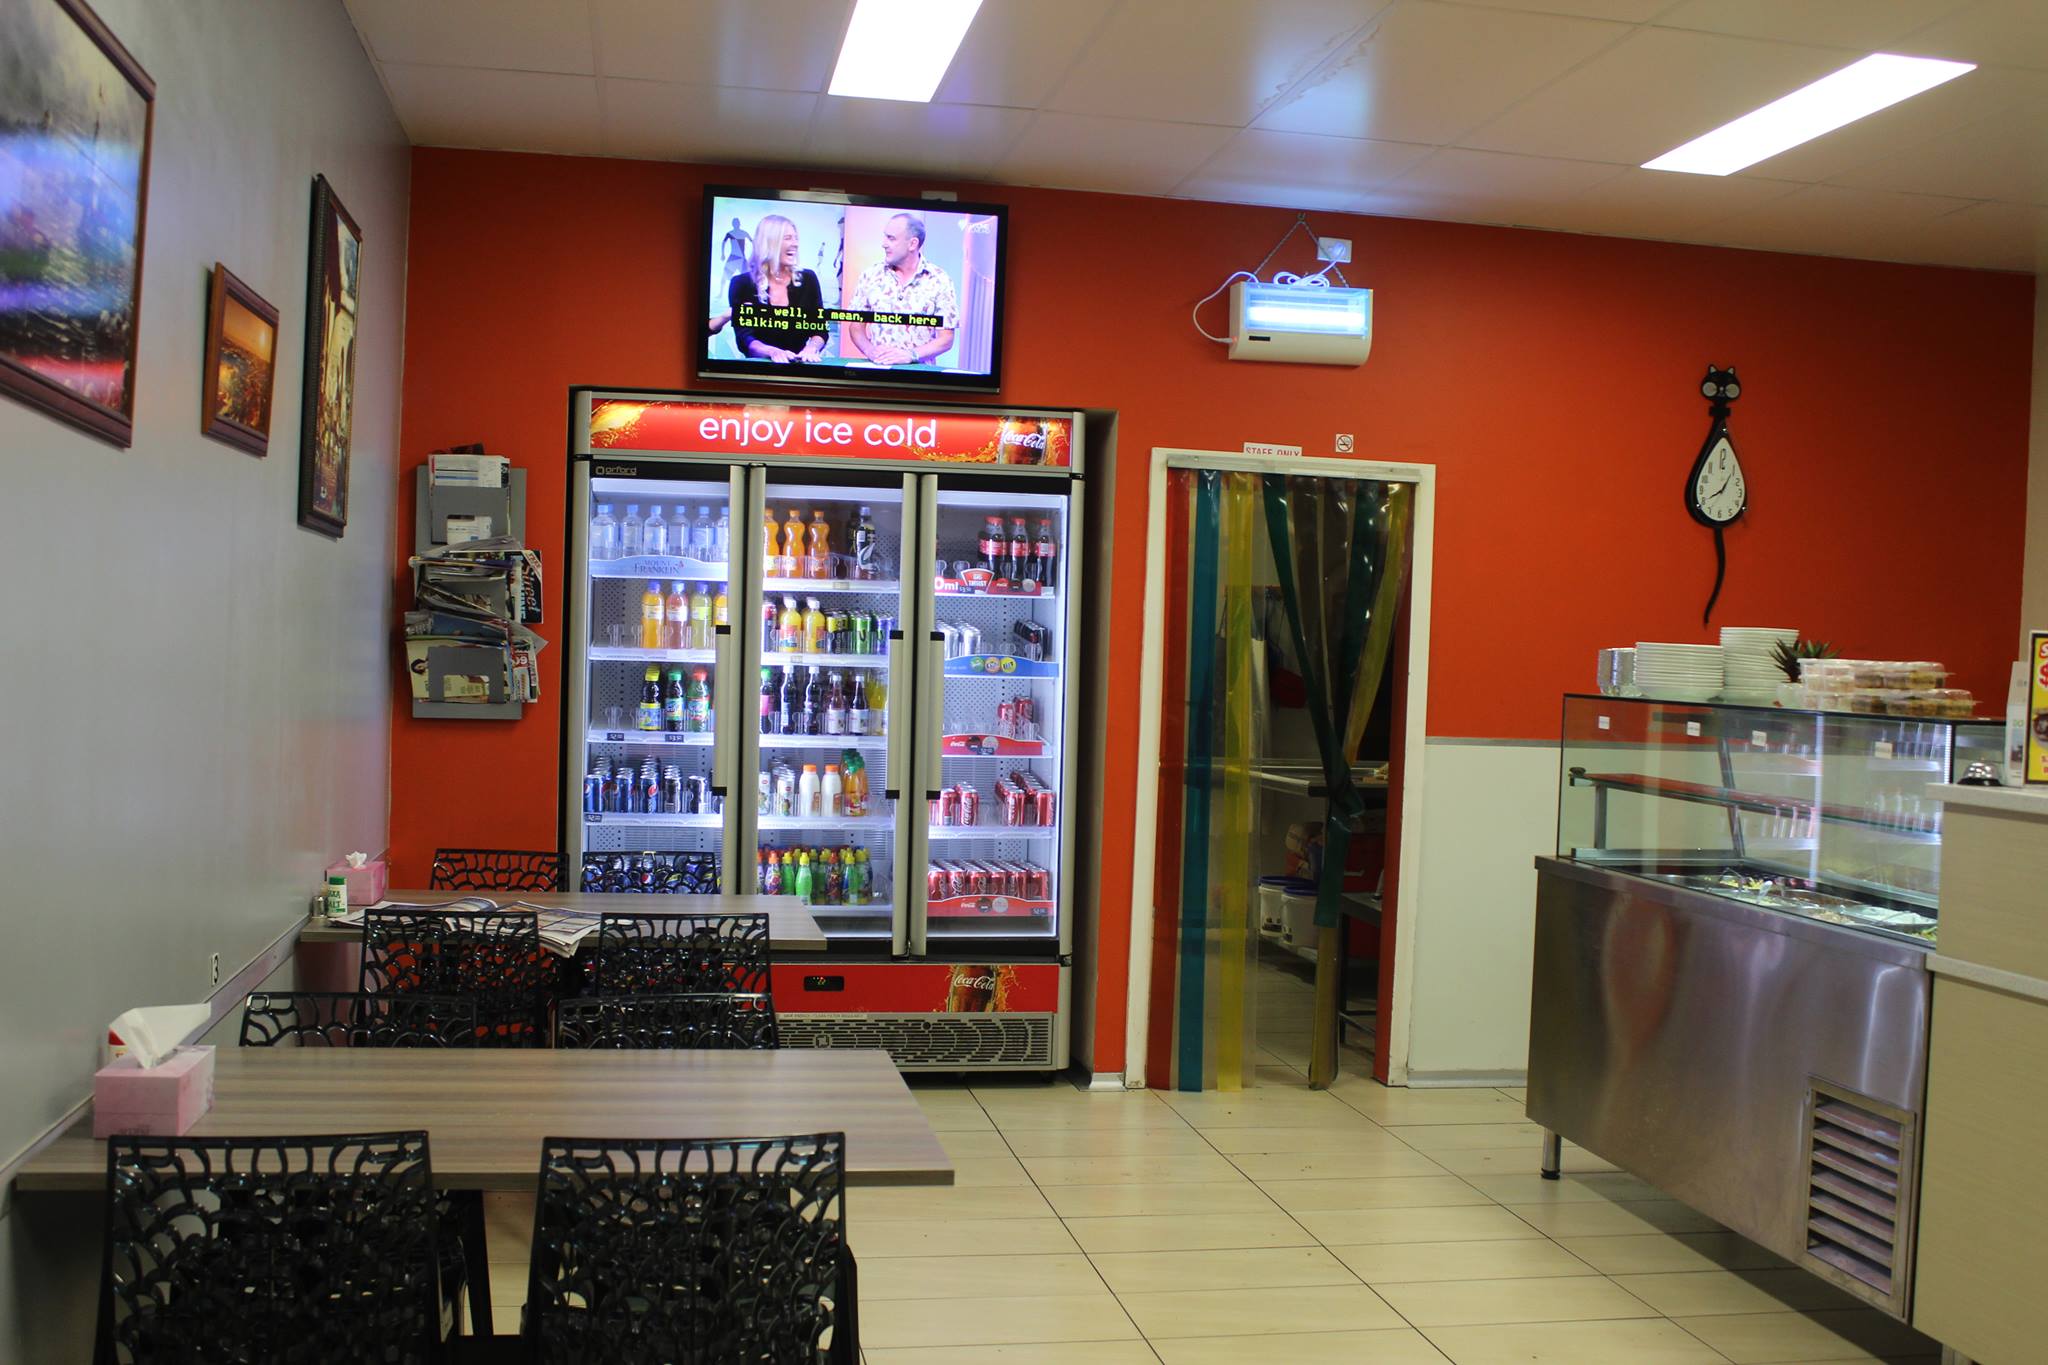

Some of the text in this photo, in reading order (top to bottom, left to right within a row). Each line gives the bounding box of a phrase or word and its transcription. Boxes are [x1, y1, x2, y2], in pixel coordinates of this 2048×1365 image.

[739, 304, 753, 314] in
[774, 307, 807, 319] well,
[817, 308, 824, 319] I
[830, 312, 864, 323] mean,
[873, 312, 902, 324] back
[909, 315, 937, 326] here
[739, 316, 830, 331] talking about
[699, 412, 937, 448] enjoy ice cold
[1735, 477, 1741, 487] 2
[1727, 508, 1734, 517] 5
[213, 954, 219, 984] 3
[953, 974, 994, 991] Coca-Cola
